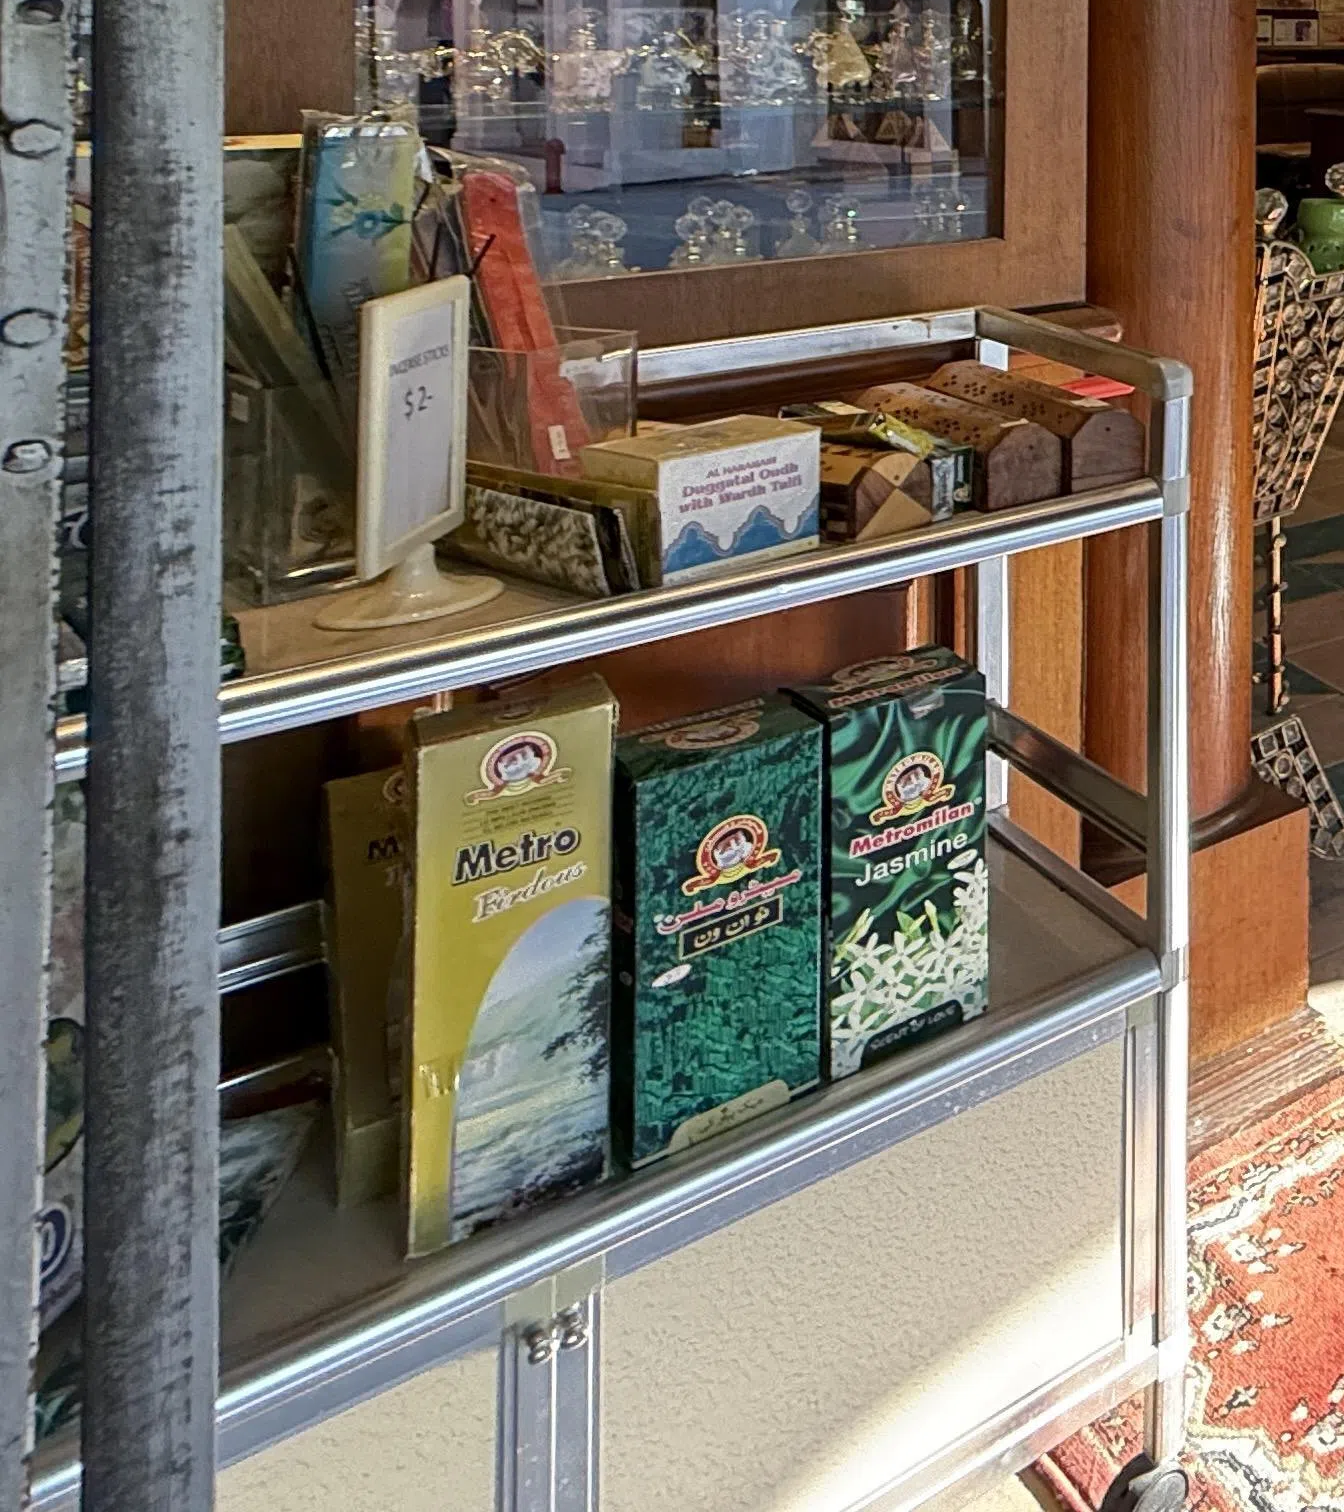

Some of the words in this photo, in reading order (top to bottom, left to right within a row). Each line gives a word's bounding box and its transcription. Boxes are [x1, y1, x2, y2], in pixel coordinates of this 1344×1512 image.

[679, 496, 713, 513] with
[452, 826, 581, 887] Metro
[850, 801, 976, 858] Metromilan
[855, 832, 968, 887] Jasmine
[472, 861, 588, 924] Firdous
